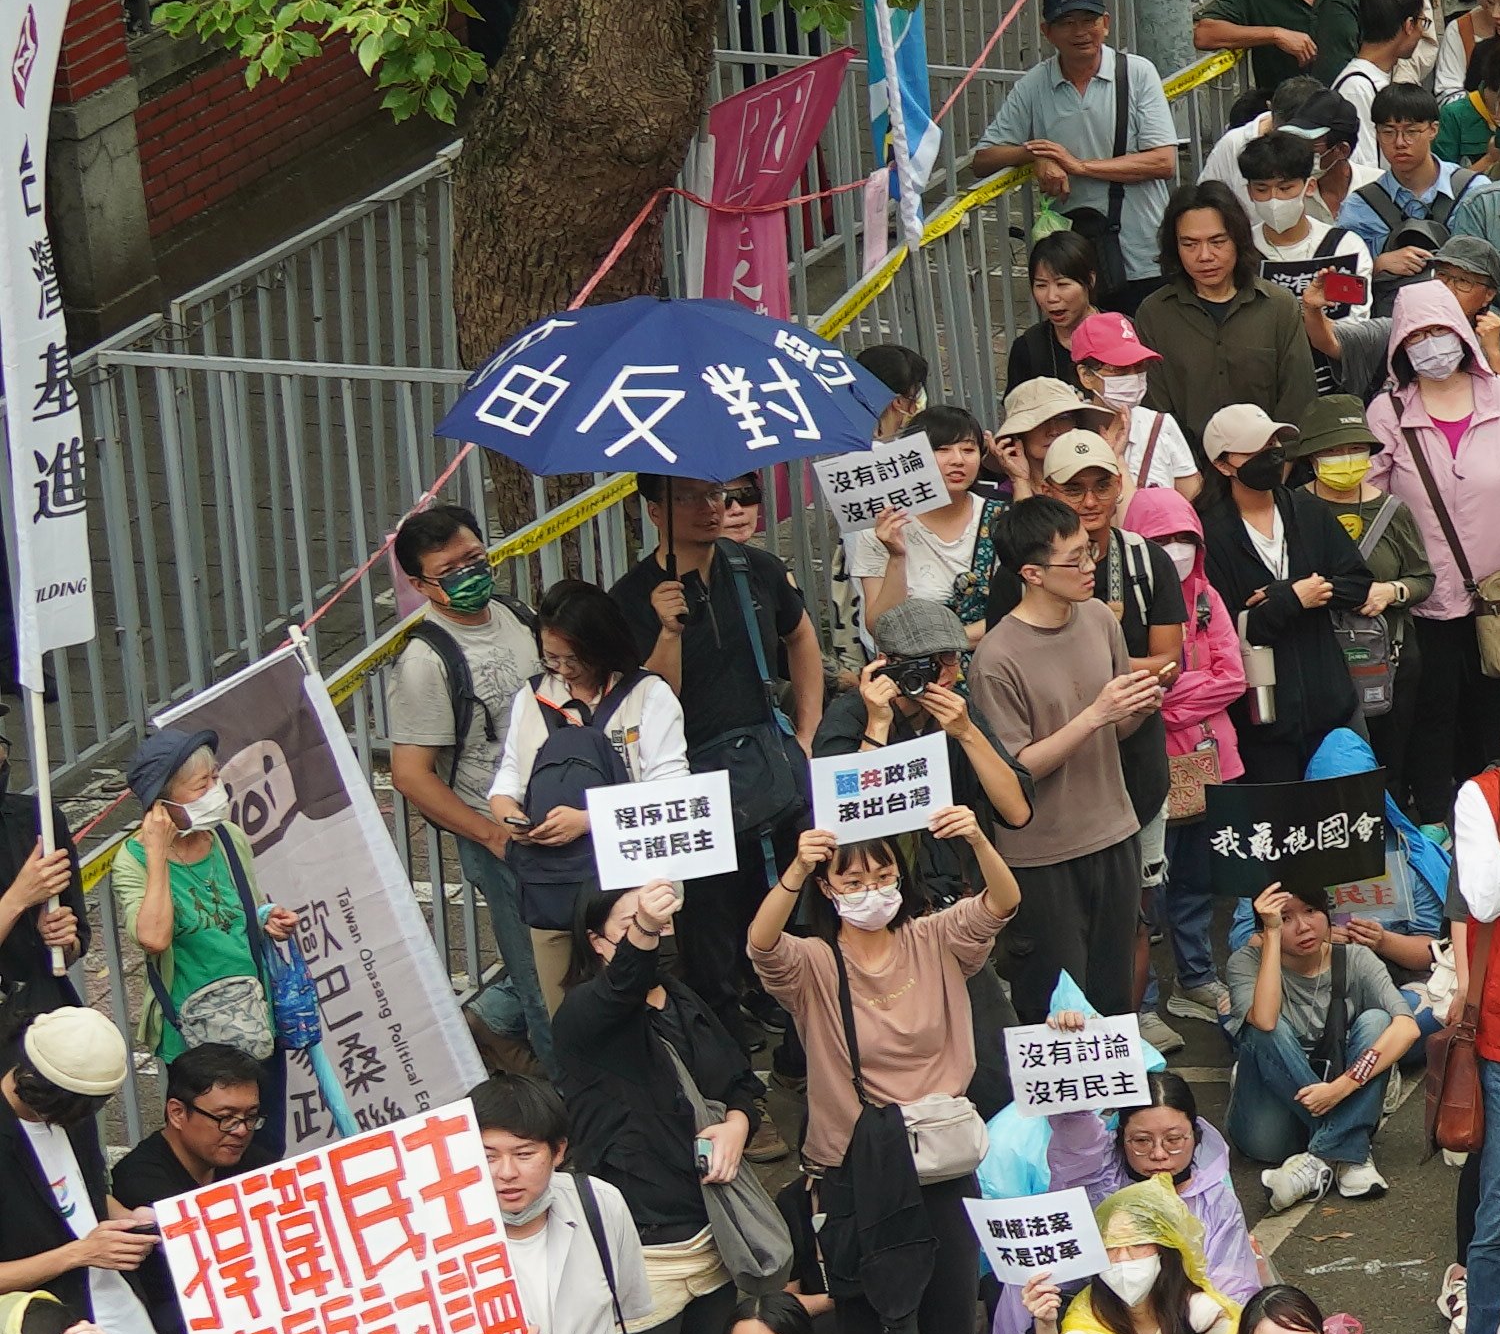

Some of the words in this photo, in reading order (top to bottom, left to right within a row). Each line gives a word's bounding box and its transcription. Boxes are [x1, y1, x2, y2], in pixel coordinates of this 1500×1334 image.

[828, 450, 924, 493] 沒有討論
[615, 796, 710, 829] 程序正義
[838, 791, 931, 825] 滾出台灣
[619, 829, 714, 861] 守護民主
[1210, 812, 1383, 861] 我藐視國會
[335, 887, 359, 938] Taiwan
[359, 946, 392, 1023] Obasang
[1019, 1034, 1129, 1068] 沒有討論
[1026, 1072, 1138, 1104] 沒有民主
[163, 1114, 497, 1328] 捍衛民主
[987, 1212, 1072, 1239] 擴權法案
[997, 1239, 1082, 1267] 不是改革
